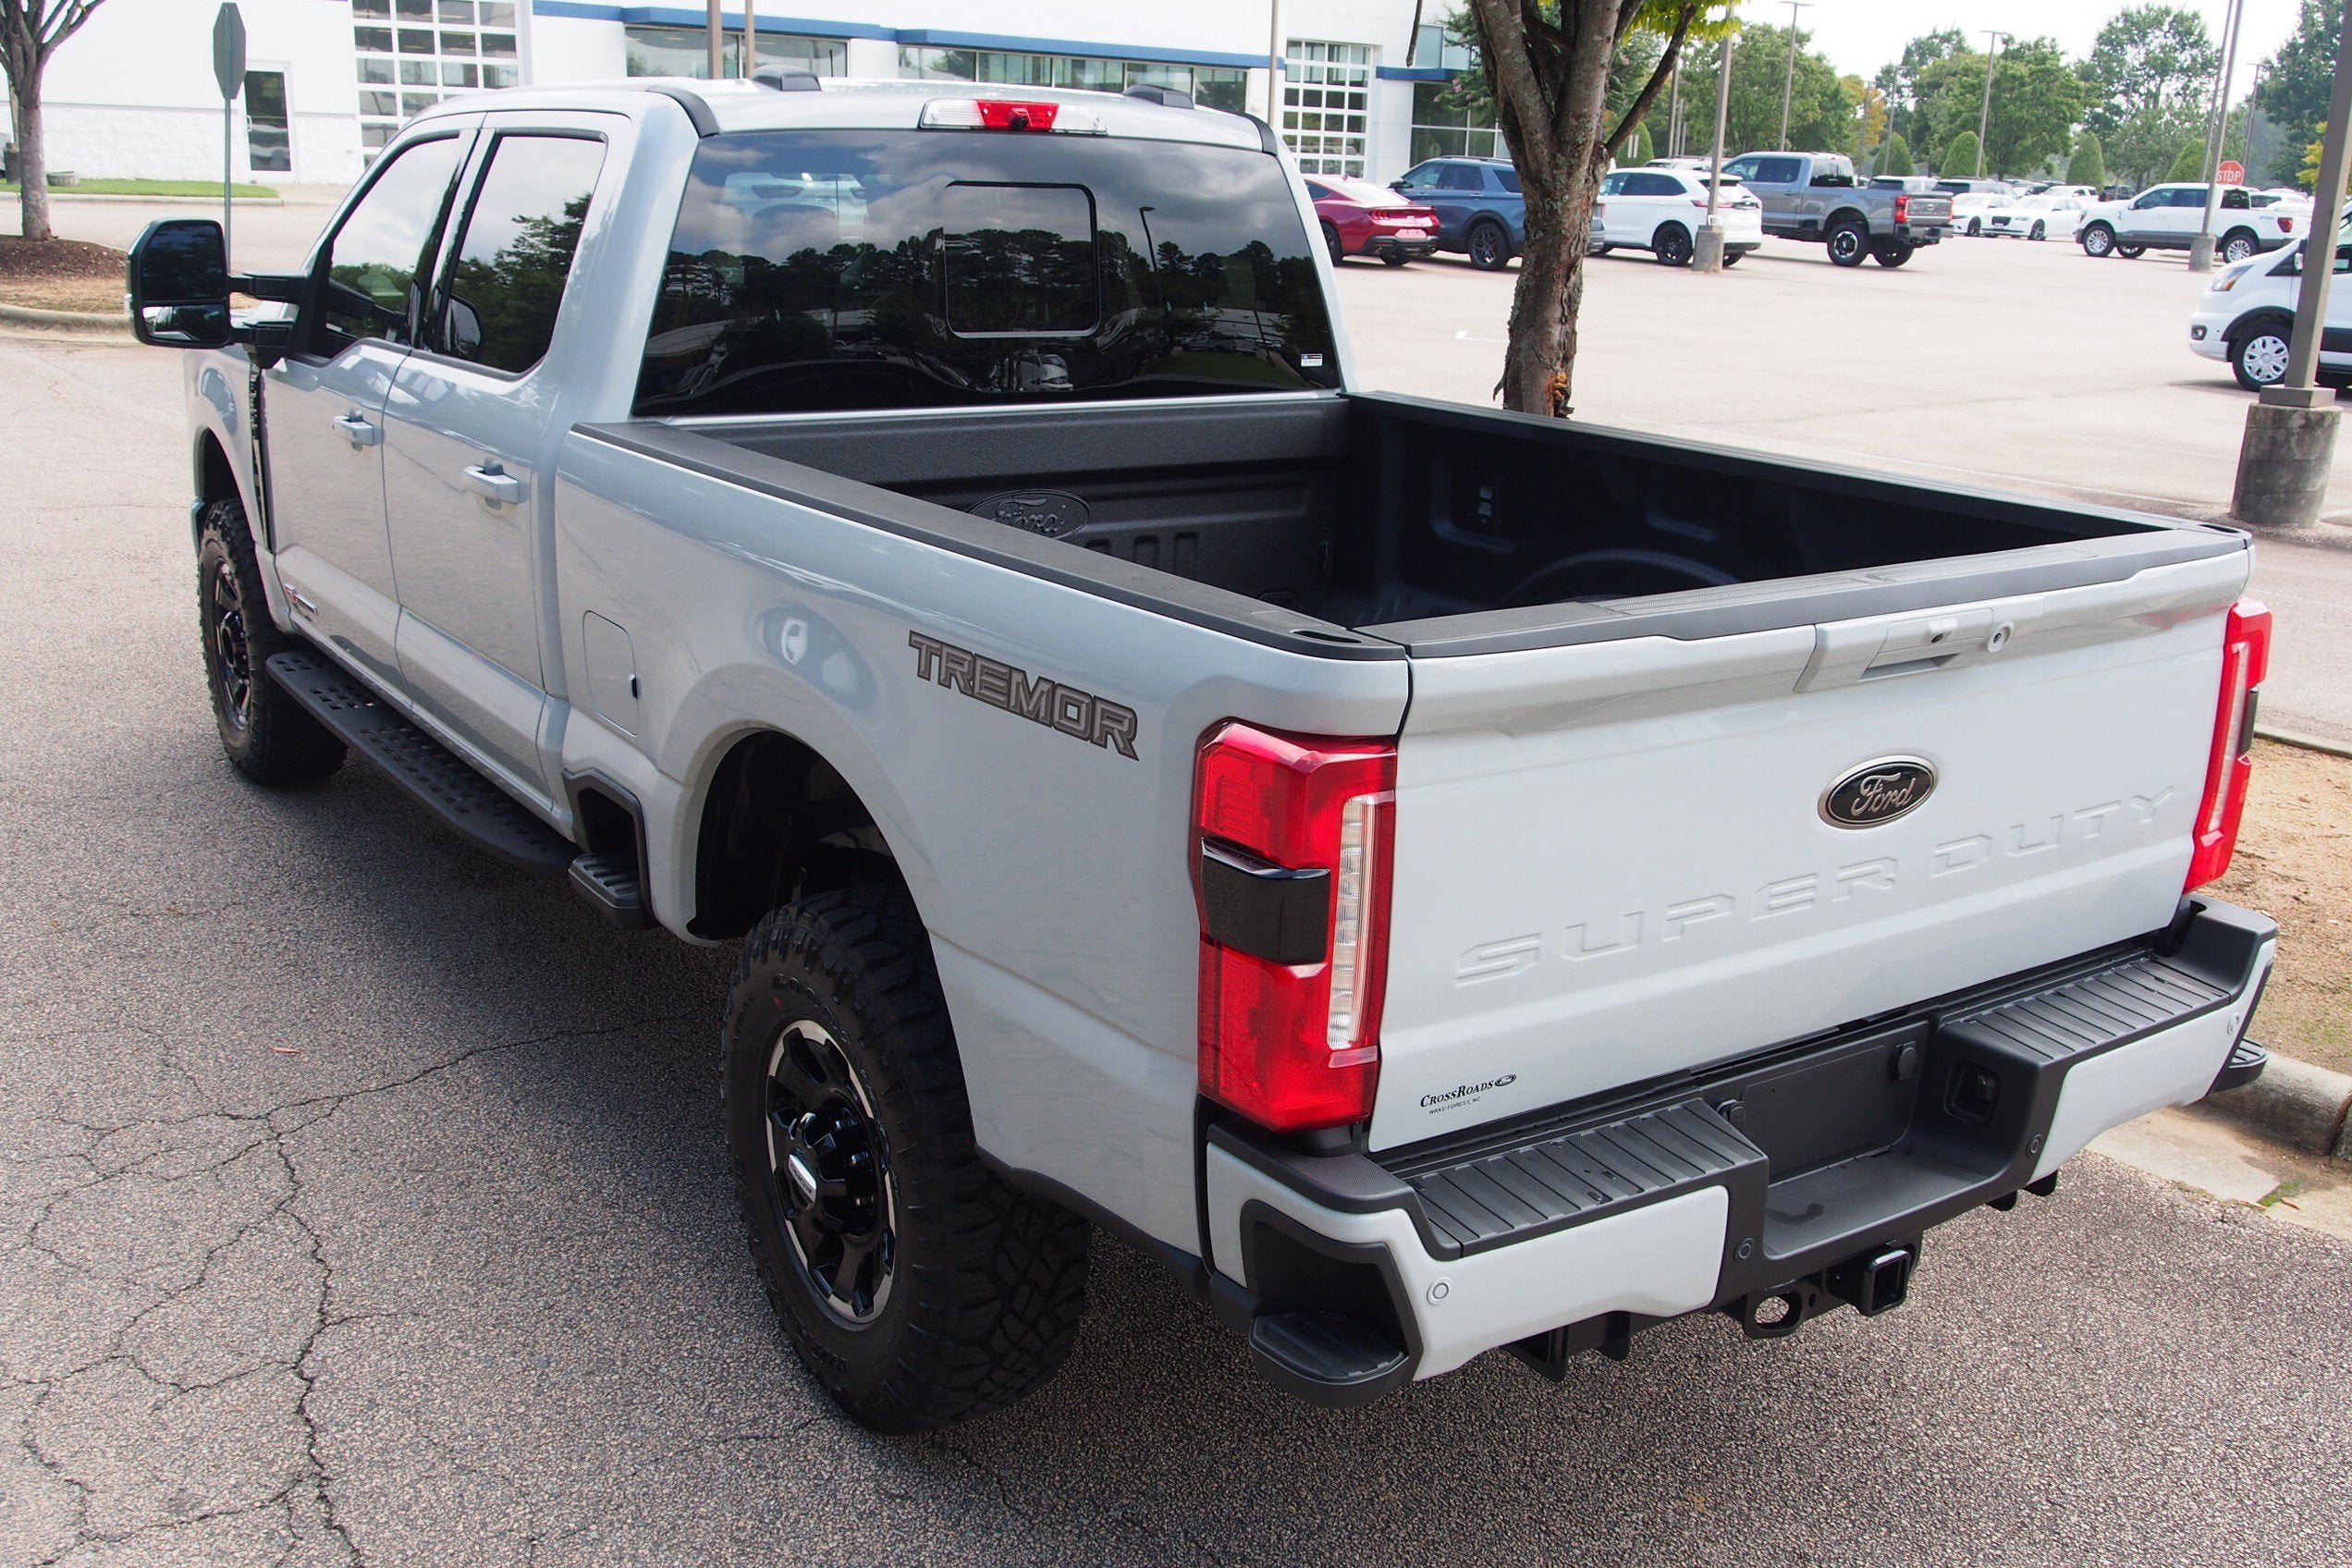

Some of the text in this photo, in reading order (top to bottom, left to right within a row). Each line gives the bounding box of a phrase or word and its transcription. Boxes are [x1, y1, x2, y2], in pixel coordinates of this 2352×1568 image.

[2217, 170, 2242, 182] STOP
[909, 630, 1140, 761] TREMOR
[1851, 772, 1916, 816] Ford
[1454, 785, 2175, 988] SUPER DUTY
[1428, 1107, 1446, 1115] WAKE
